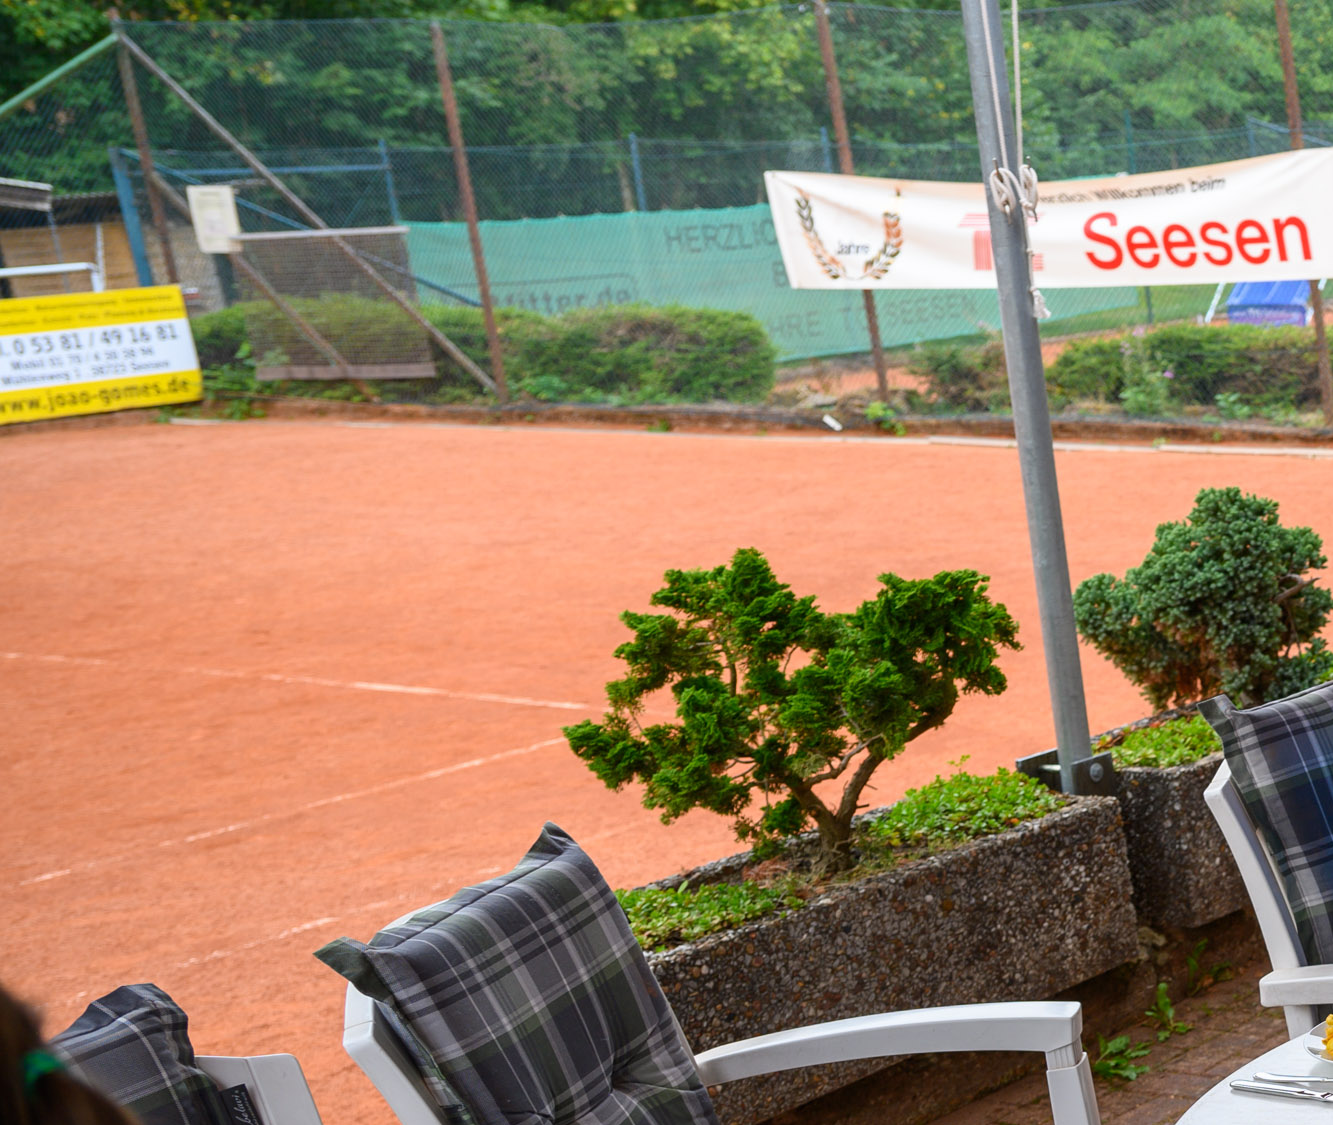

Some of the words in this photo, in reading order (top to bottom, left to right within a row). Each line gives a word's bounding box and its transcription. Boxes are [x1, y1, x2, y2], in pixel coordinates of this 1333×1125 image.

[1093, 181, 1185, 201] Willkommen
[1190, 176, 1226, 192] beim
[1083, 211, 1313, 271] Seesen
